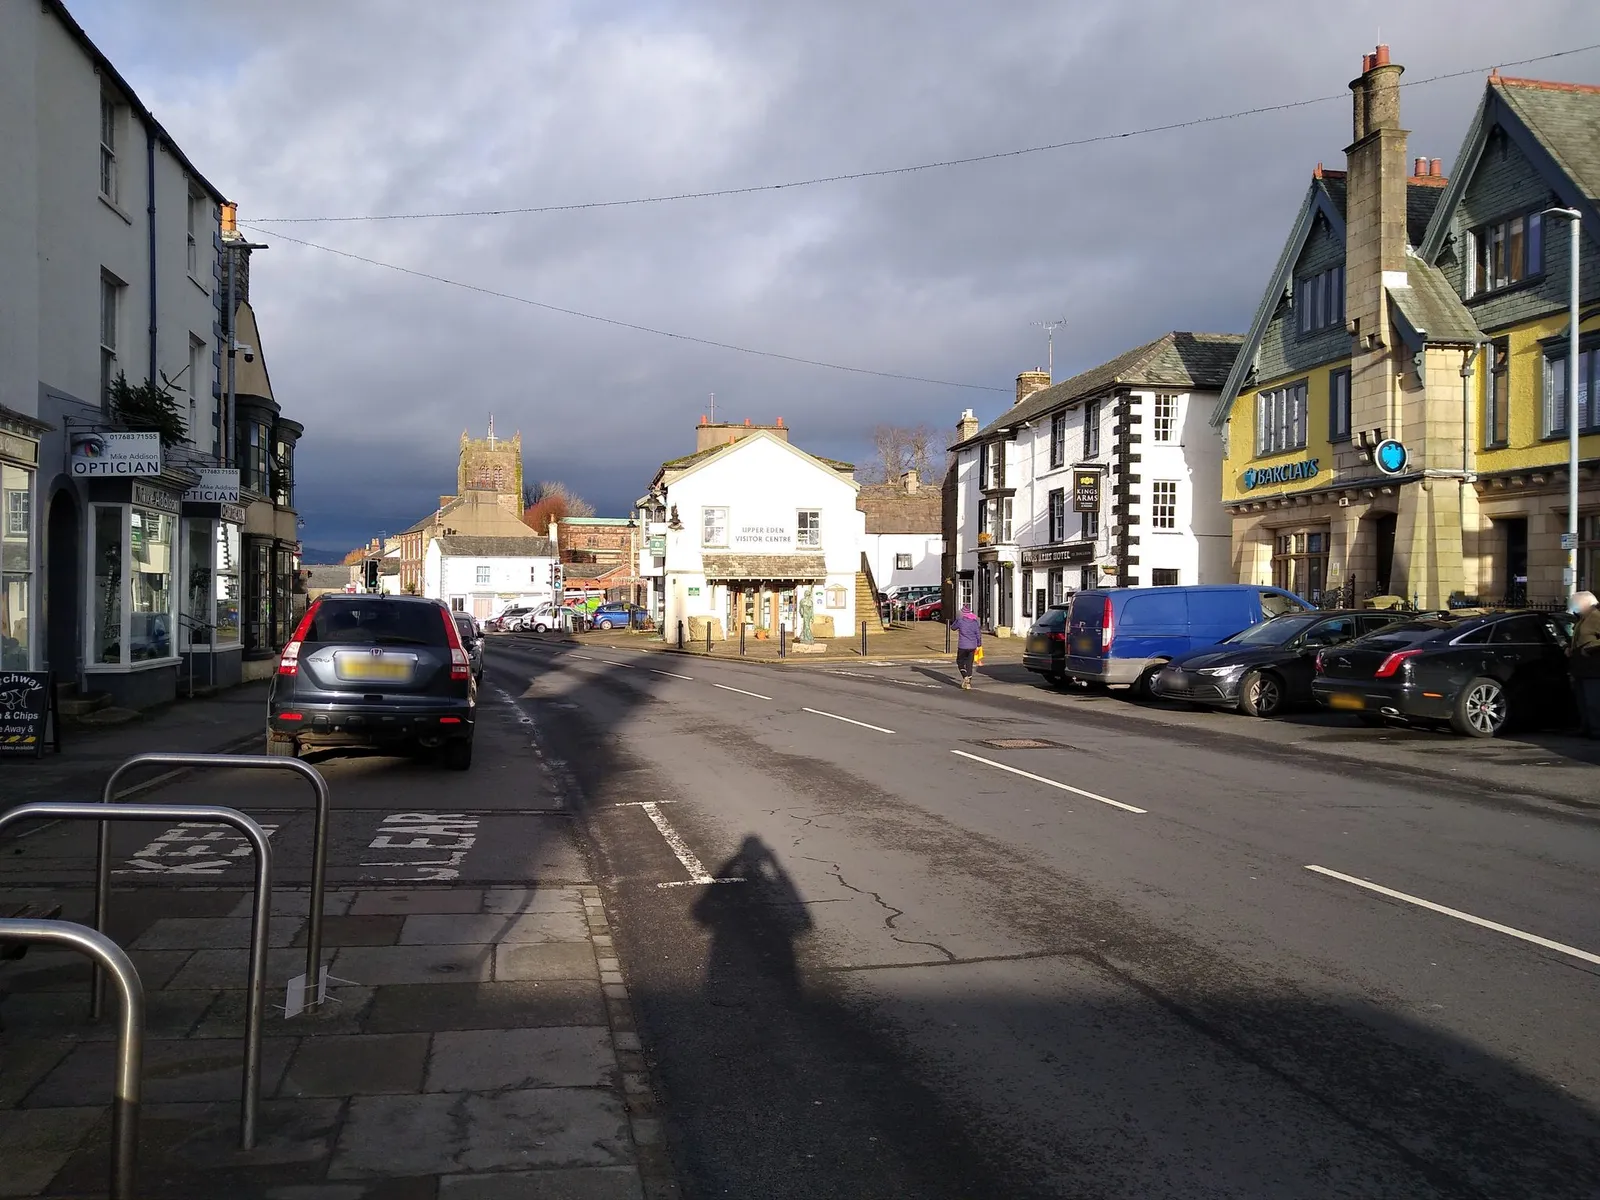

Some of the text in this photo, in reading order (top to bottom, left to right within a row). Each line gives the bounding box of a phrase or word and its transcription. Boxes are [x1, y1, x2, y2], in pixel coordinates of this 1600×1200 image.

[74, 461, 159, 474] OPTICIAN
[1257, 458, 1319, 485] BARCLAYS
[182, 490, 238, 501] PTICIAN
[735, 535, 792, 543] VISITOR CENTRE
[1053, 550, 1071, 561] HOTEL
[0, 673, 43, 691] chway
[13, 711, 39, 721] Chips
[4, 725, 26, 735] Away
